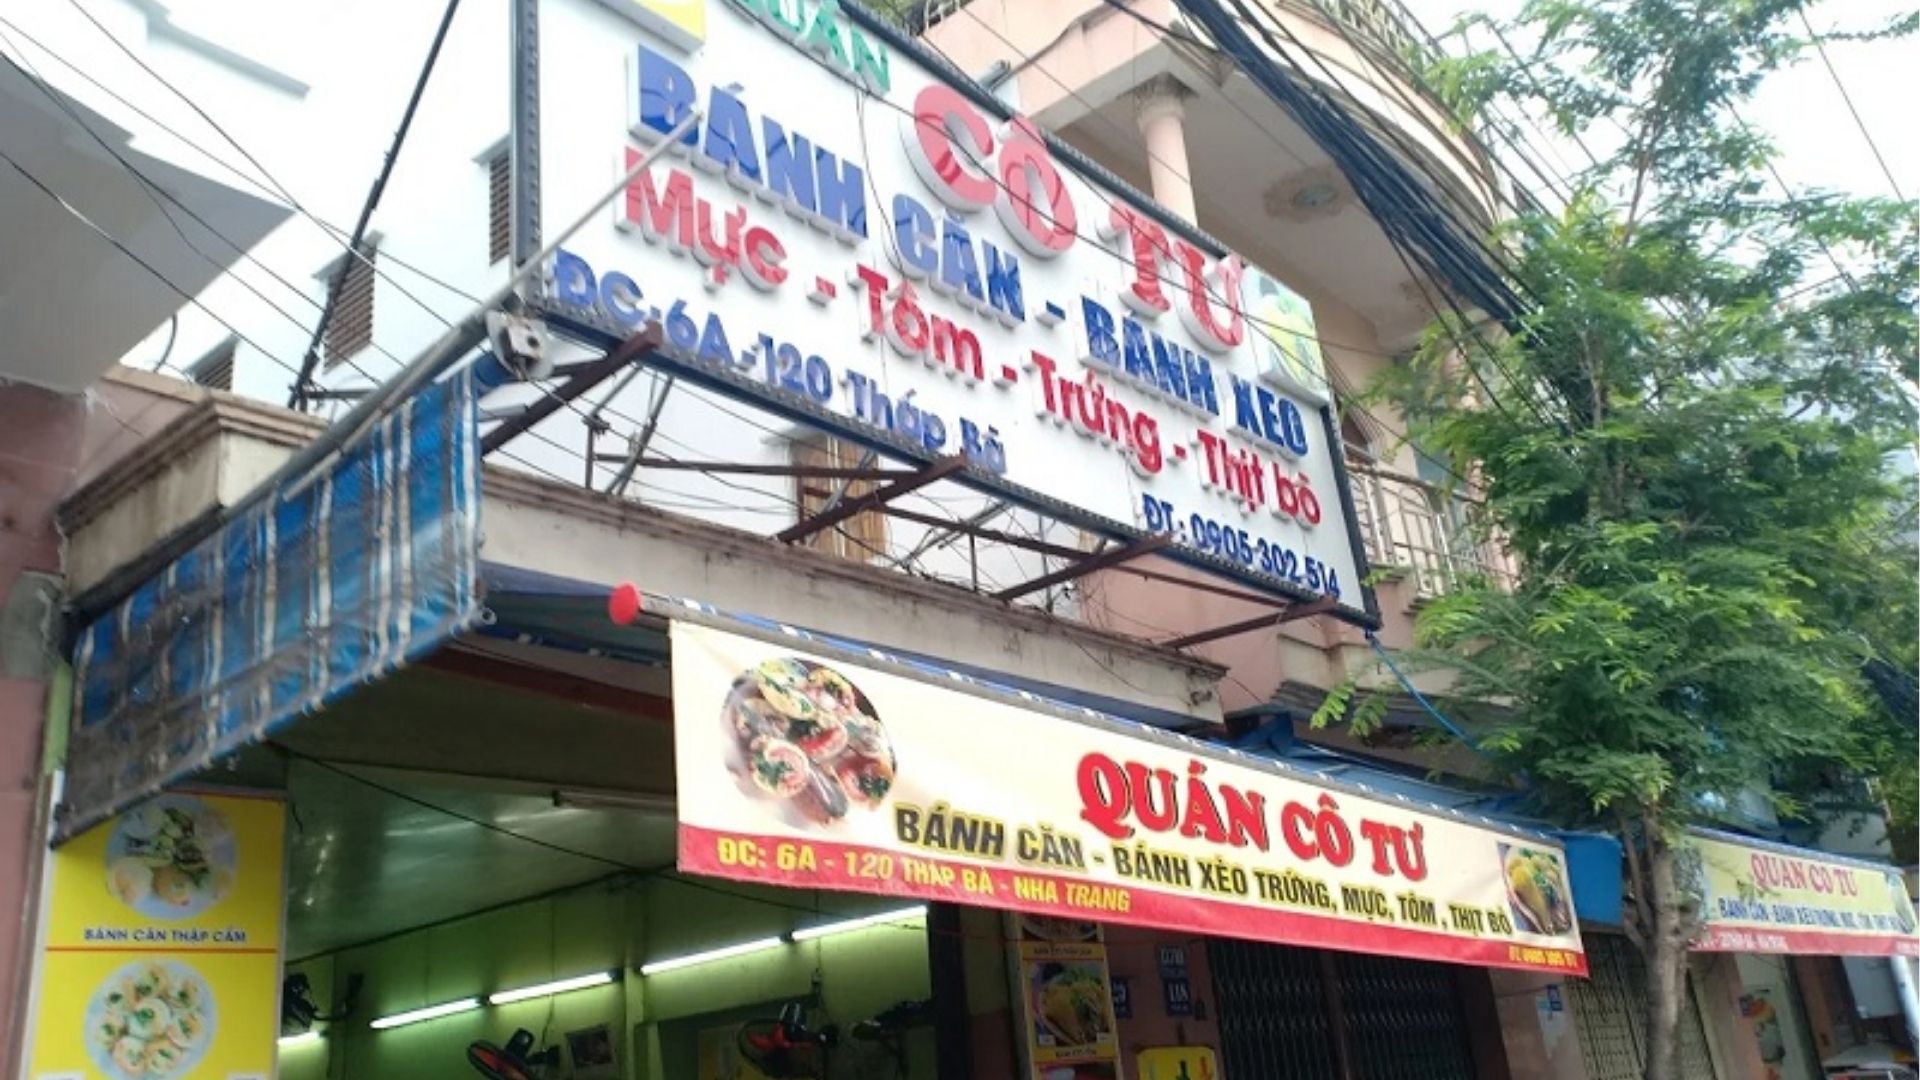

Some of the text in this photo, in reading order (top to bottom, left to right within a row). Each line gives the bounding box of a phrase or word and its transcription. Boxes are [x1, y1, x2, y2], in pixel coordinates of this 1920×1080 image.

[638, 43, 867, 237] BÁNH
[914, 86, 1244, 348] CÔ TƯ
[624, 145, 788, 285] Mực
[857, 263, 984, 380] Tôm
[1031, 350, 1162, 474] Trứng
[1197, 429, 1264, 512] Thịt
[847, 368, 946, 452] Tháp
[717, 837, 766, 868] ĐC:
[777, 843, 817, 871] 6A
[845, 852, 893, 880] 120
[963, 867, 993, 895] BÀ
[1015, 876, 1059, 904] NHA
[1065, 883, 1130, 912] TRANG
[896, 804, 1005, 857] BÁNH
[1017, 825, 1086, 869] CĂN
[1113, 845, 1191, 887] BÁNH
[1199, 860, 1247, 895] XÈO
[1450, 906, 1483, 936] THỊT
[1488, 907, 1513, 935] BÒ
[1076, 752, 1428, 882] QUÁN CÔ TƯ
